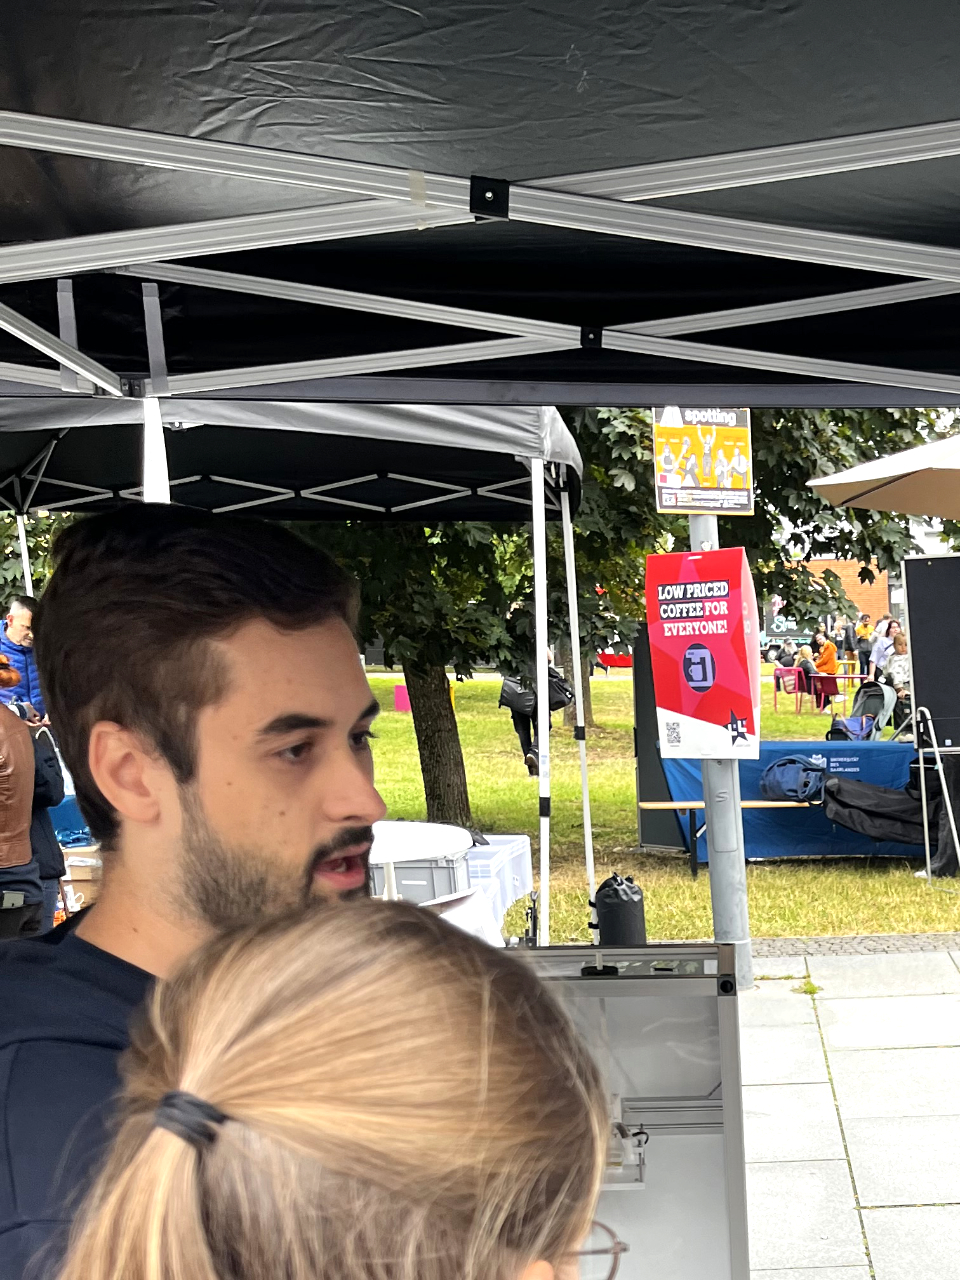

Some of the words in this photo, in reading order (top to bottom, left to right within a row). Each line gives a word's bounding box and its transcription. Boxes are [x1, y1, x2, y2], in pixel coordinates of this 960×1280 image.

[684, 407, 737, 427] spotting
[658, 584, 685, 600] LOW
[686, 581, 729, 598] PRICED
[660, 602, 704, 619] COFFEE
[704, 601, 729, 615] FOR
[663, 620, 728, 637] EVERYONE!
